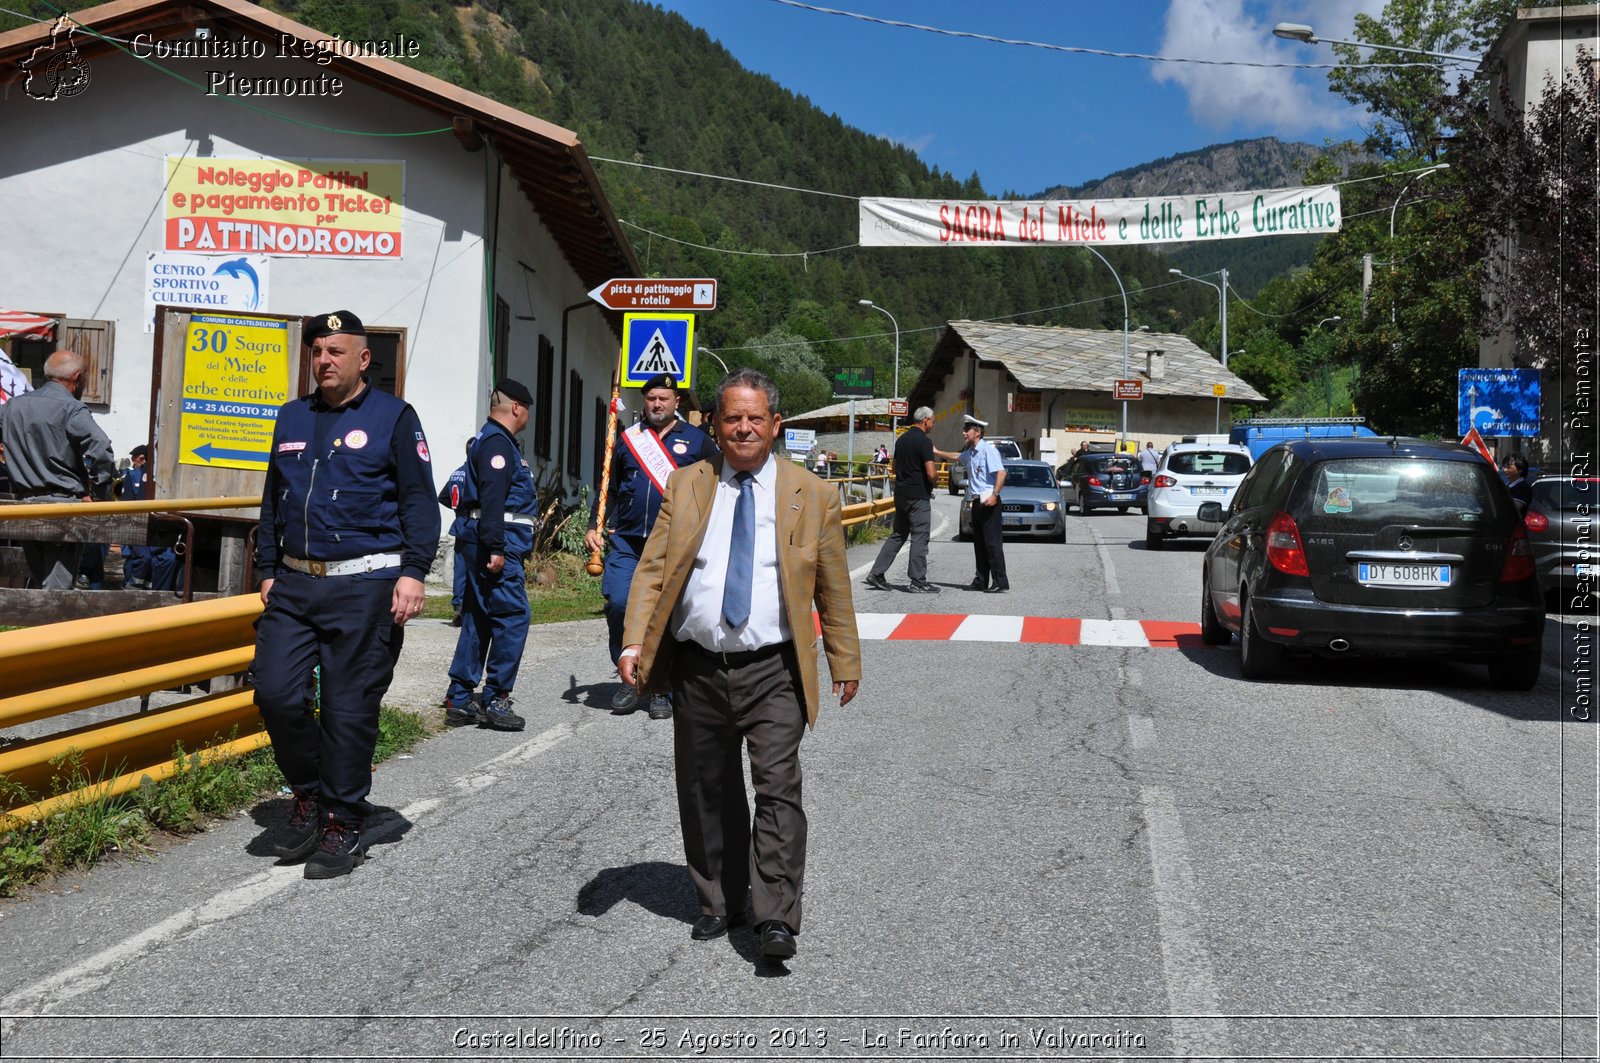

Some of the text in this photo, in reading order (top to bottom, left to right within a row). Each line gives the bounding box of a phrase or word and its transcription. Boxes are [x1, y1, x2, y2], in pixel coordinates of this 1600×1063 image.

[197, 167, 368, 192] Noleggio Pattini
[172, 193, 392, 215] e pagamento Ticket
[316, 213, 338, 225] per
[939, 195, 1335, 242] SAGRA del Miele e delle Erbe Curative
[178, 219, 395, 254] PATTINODROMO
[153, 264, 205, 276] CENTRO
[153, 278, 220, 291] SPORTIVO
[611, 284, 692, 296] pista di pattinaggio
[152, 292, 228, 305] CULTURALE
[641, 295, 671, 304] rotelle
[235, 319, 280, 328] CASTELDELFINO
[235, 336, 281, 355] Sagra
[207, 357, 267, 373] del Miele
[228, 374, 248, 383] delle
[185, 381, 285, 401] erbe curative
[185, 402, 196, 410] 24
[205, 403, 216, 412] 25
[219, 405, 259, 415] AGOSTO
[262, 408, 279, 417] 201
[188, 424, 230, 433] Polifunzionale
[238, 421, 263, 429] Sportivo
[217, 434, 267, 443] Circonvallazione
[1369, 566, 1439, 581] DY 608HK
